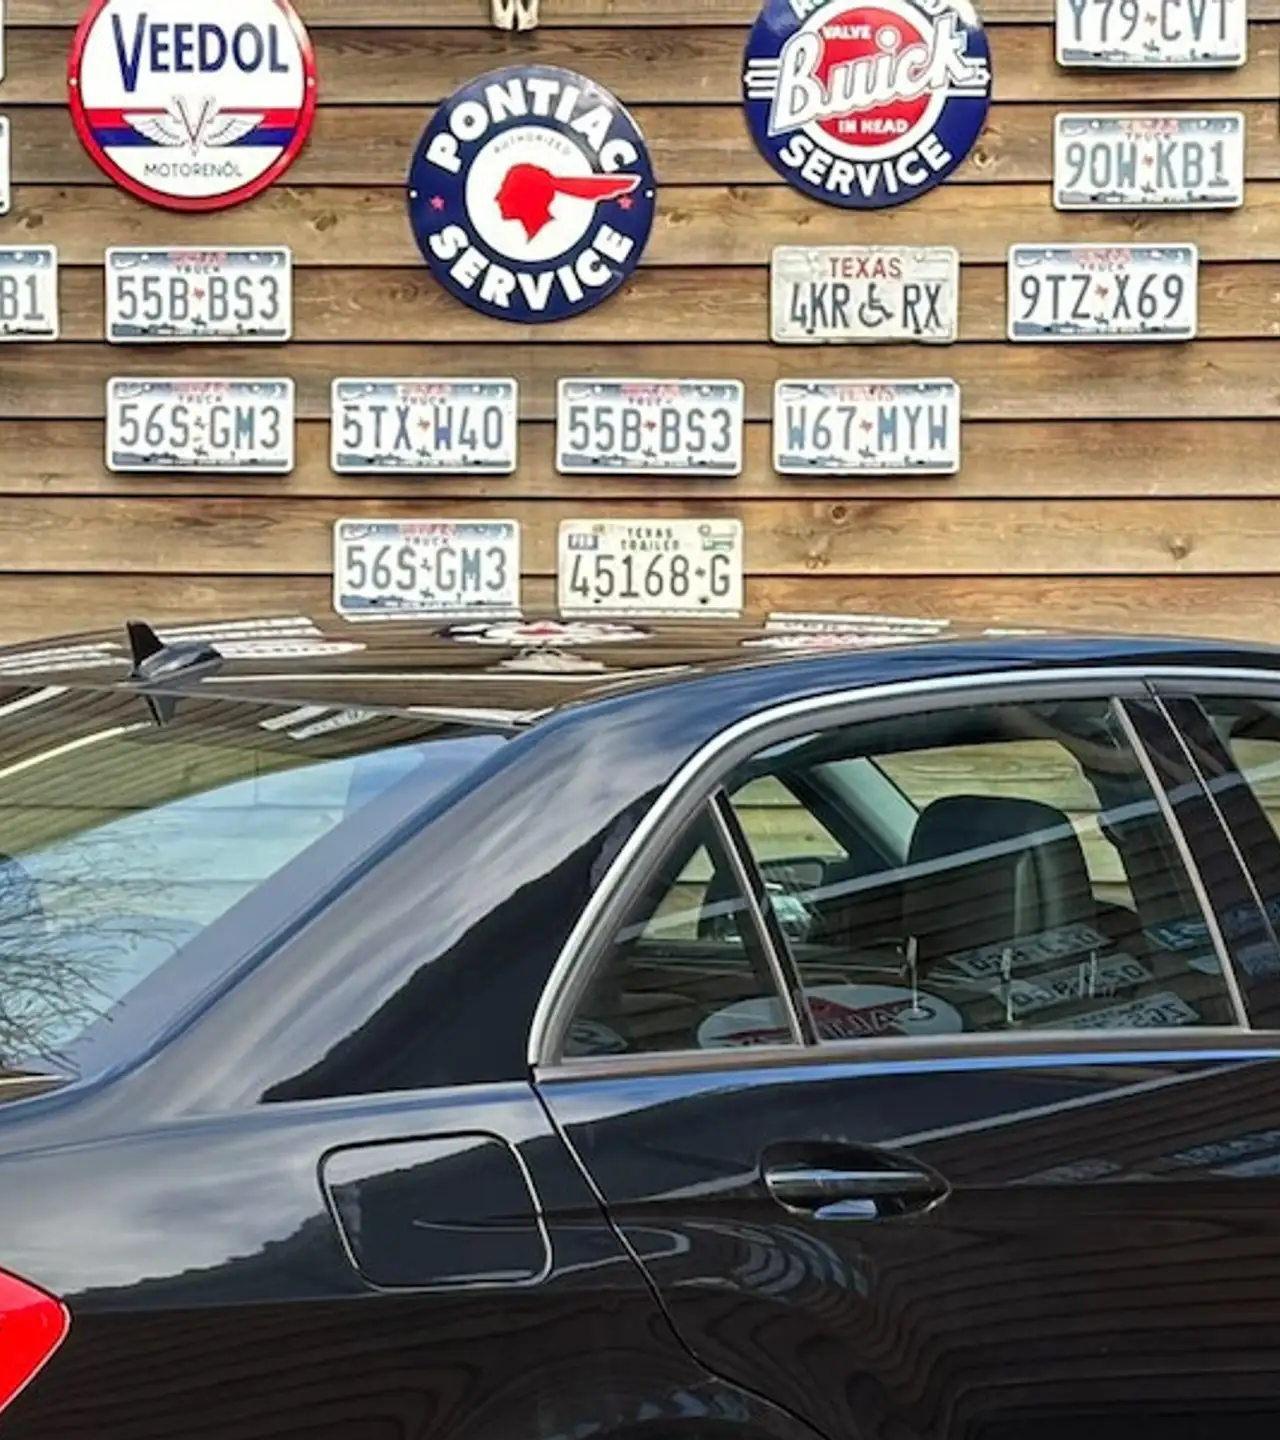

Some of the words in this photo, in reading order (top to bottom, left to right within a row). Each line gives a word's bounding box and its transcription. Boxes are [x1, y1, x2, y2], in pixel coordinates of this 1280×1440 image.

[111, 13, 289, 92] VEEDOL
[767, 13, 967, 136] Buick
[425, 78, 639, 173] PONTIAC
[779, 133, 952, 197] SERVICE
[428, 224, 634, 310] SERVICE
[829, 256, 902, 280] TEXAS
[790, 281, 851, 328] 4KR
[902, 283, 942, 329] RX
[571, 554, 689, 598] 45168
